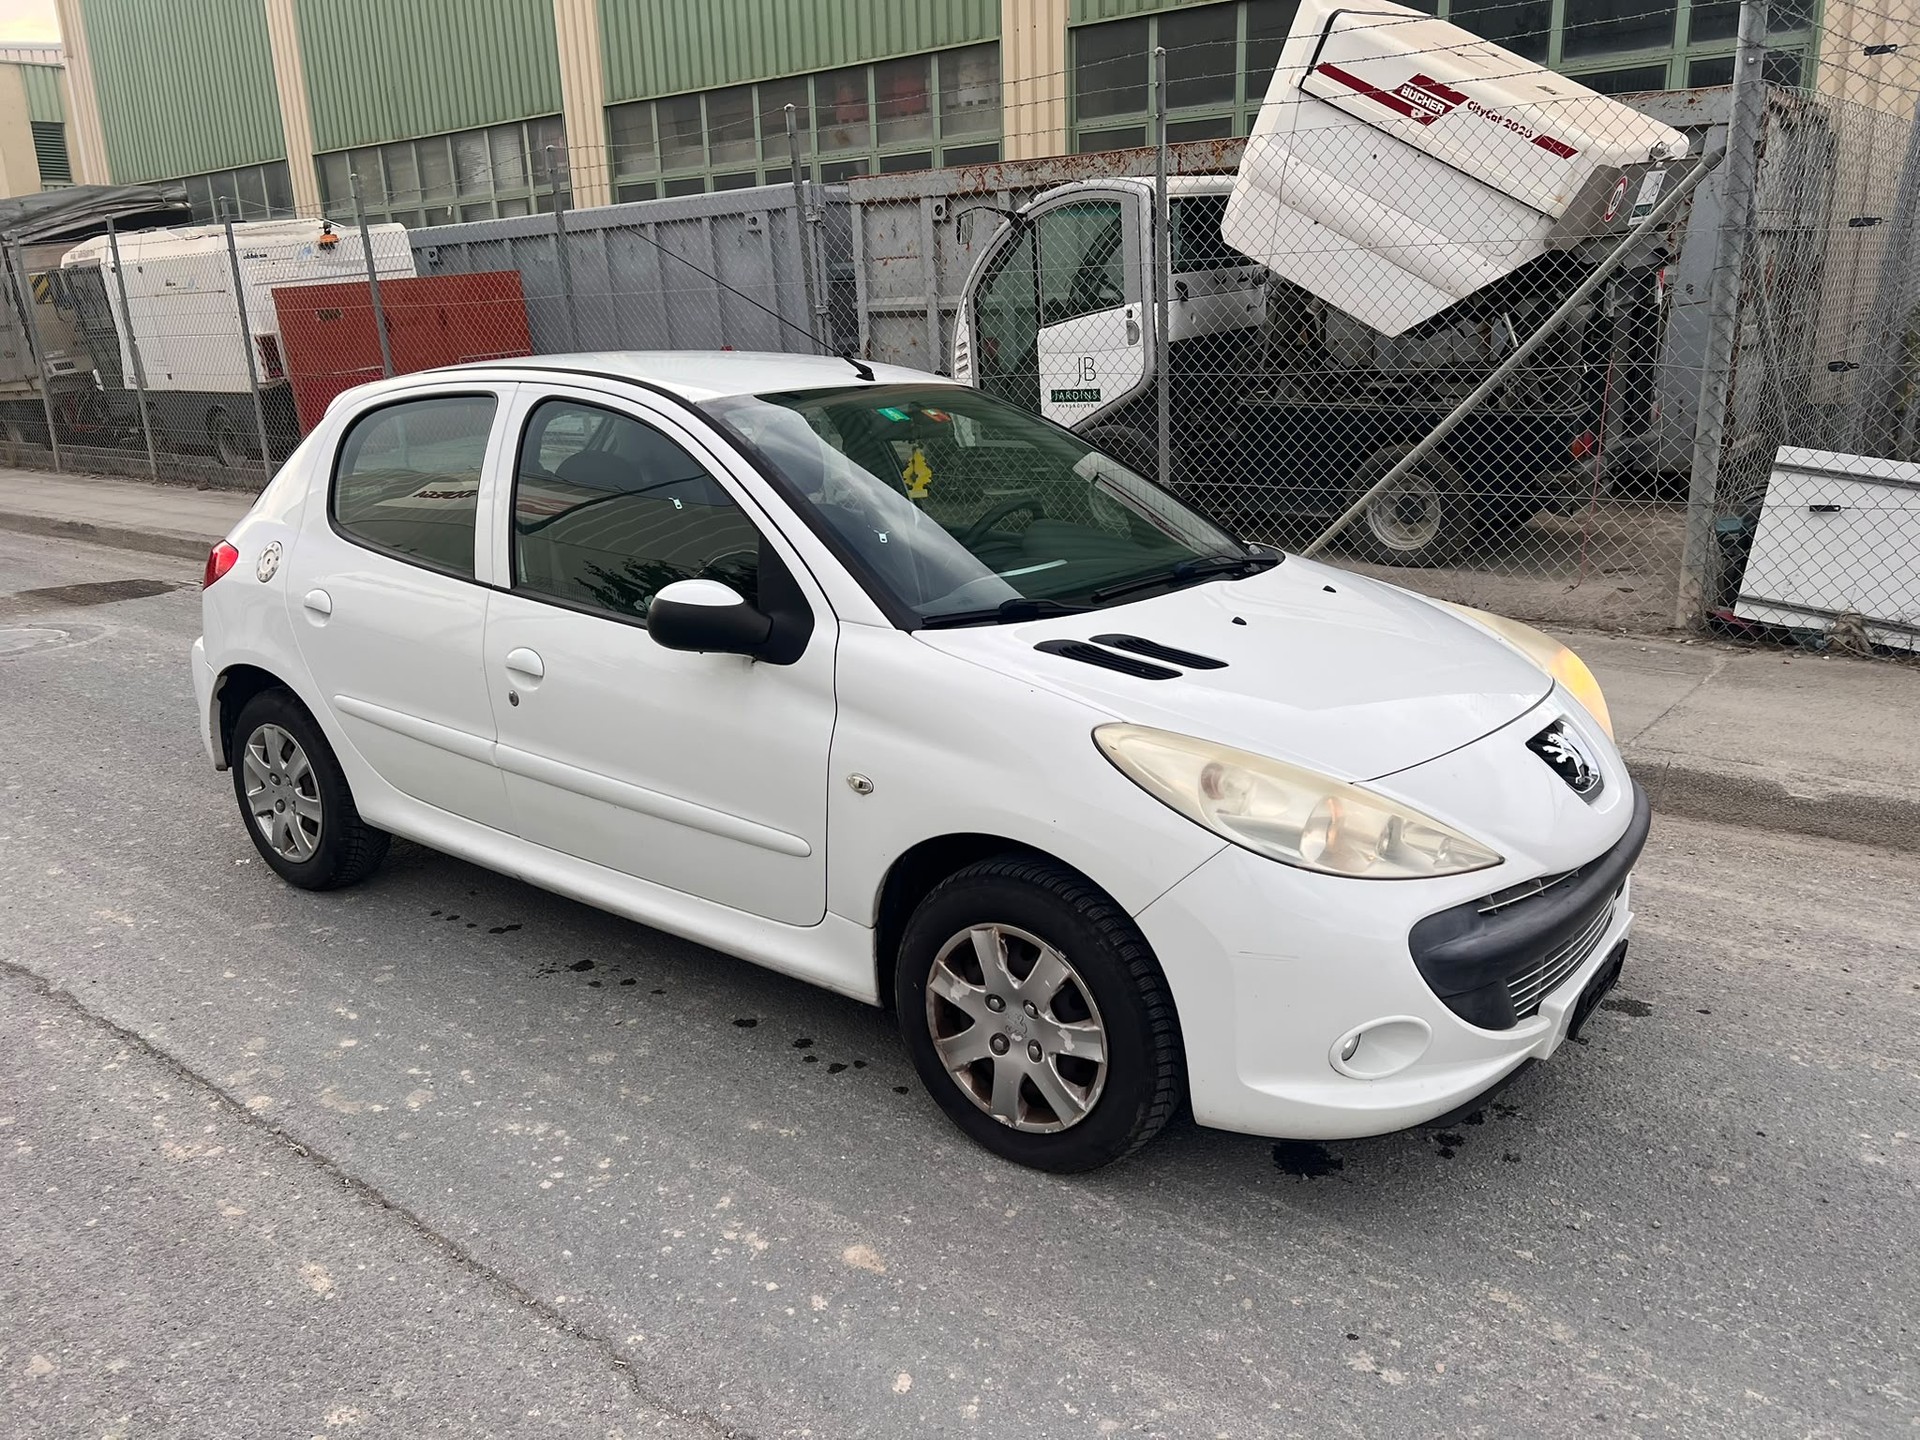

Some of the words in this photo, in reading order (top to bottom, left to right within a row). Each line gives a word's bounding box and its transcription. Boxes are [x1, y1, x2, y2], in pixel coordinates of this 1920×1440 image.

[1401, 86, 1445, 114] BUCHER
[1502, 118, 1533, 138] 2020
[1075, 356, 1096, 387] JB
[1054, 391, 1097, 401] JARDINS
